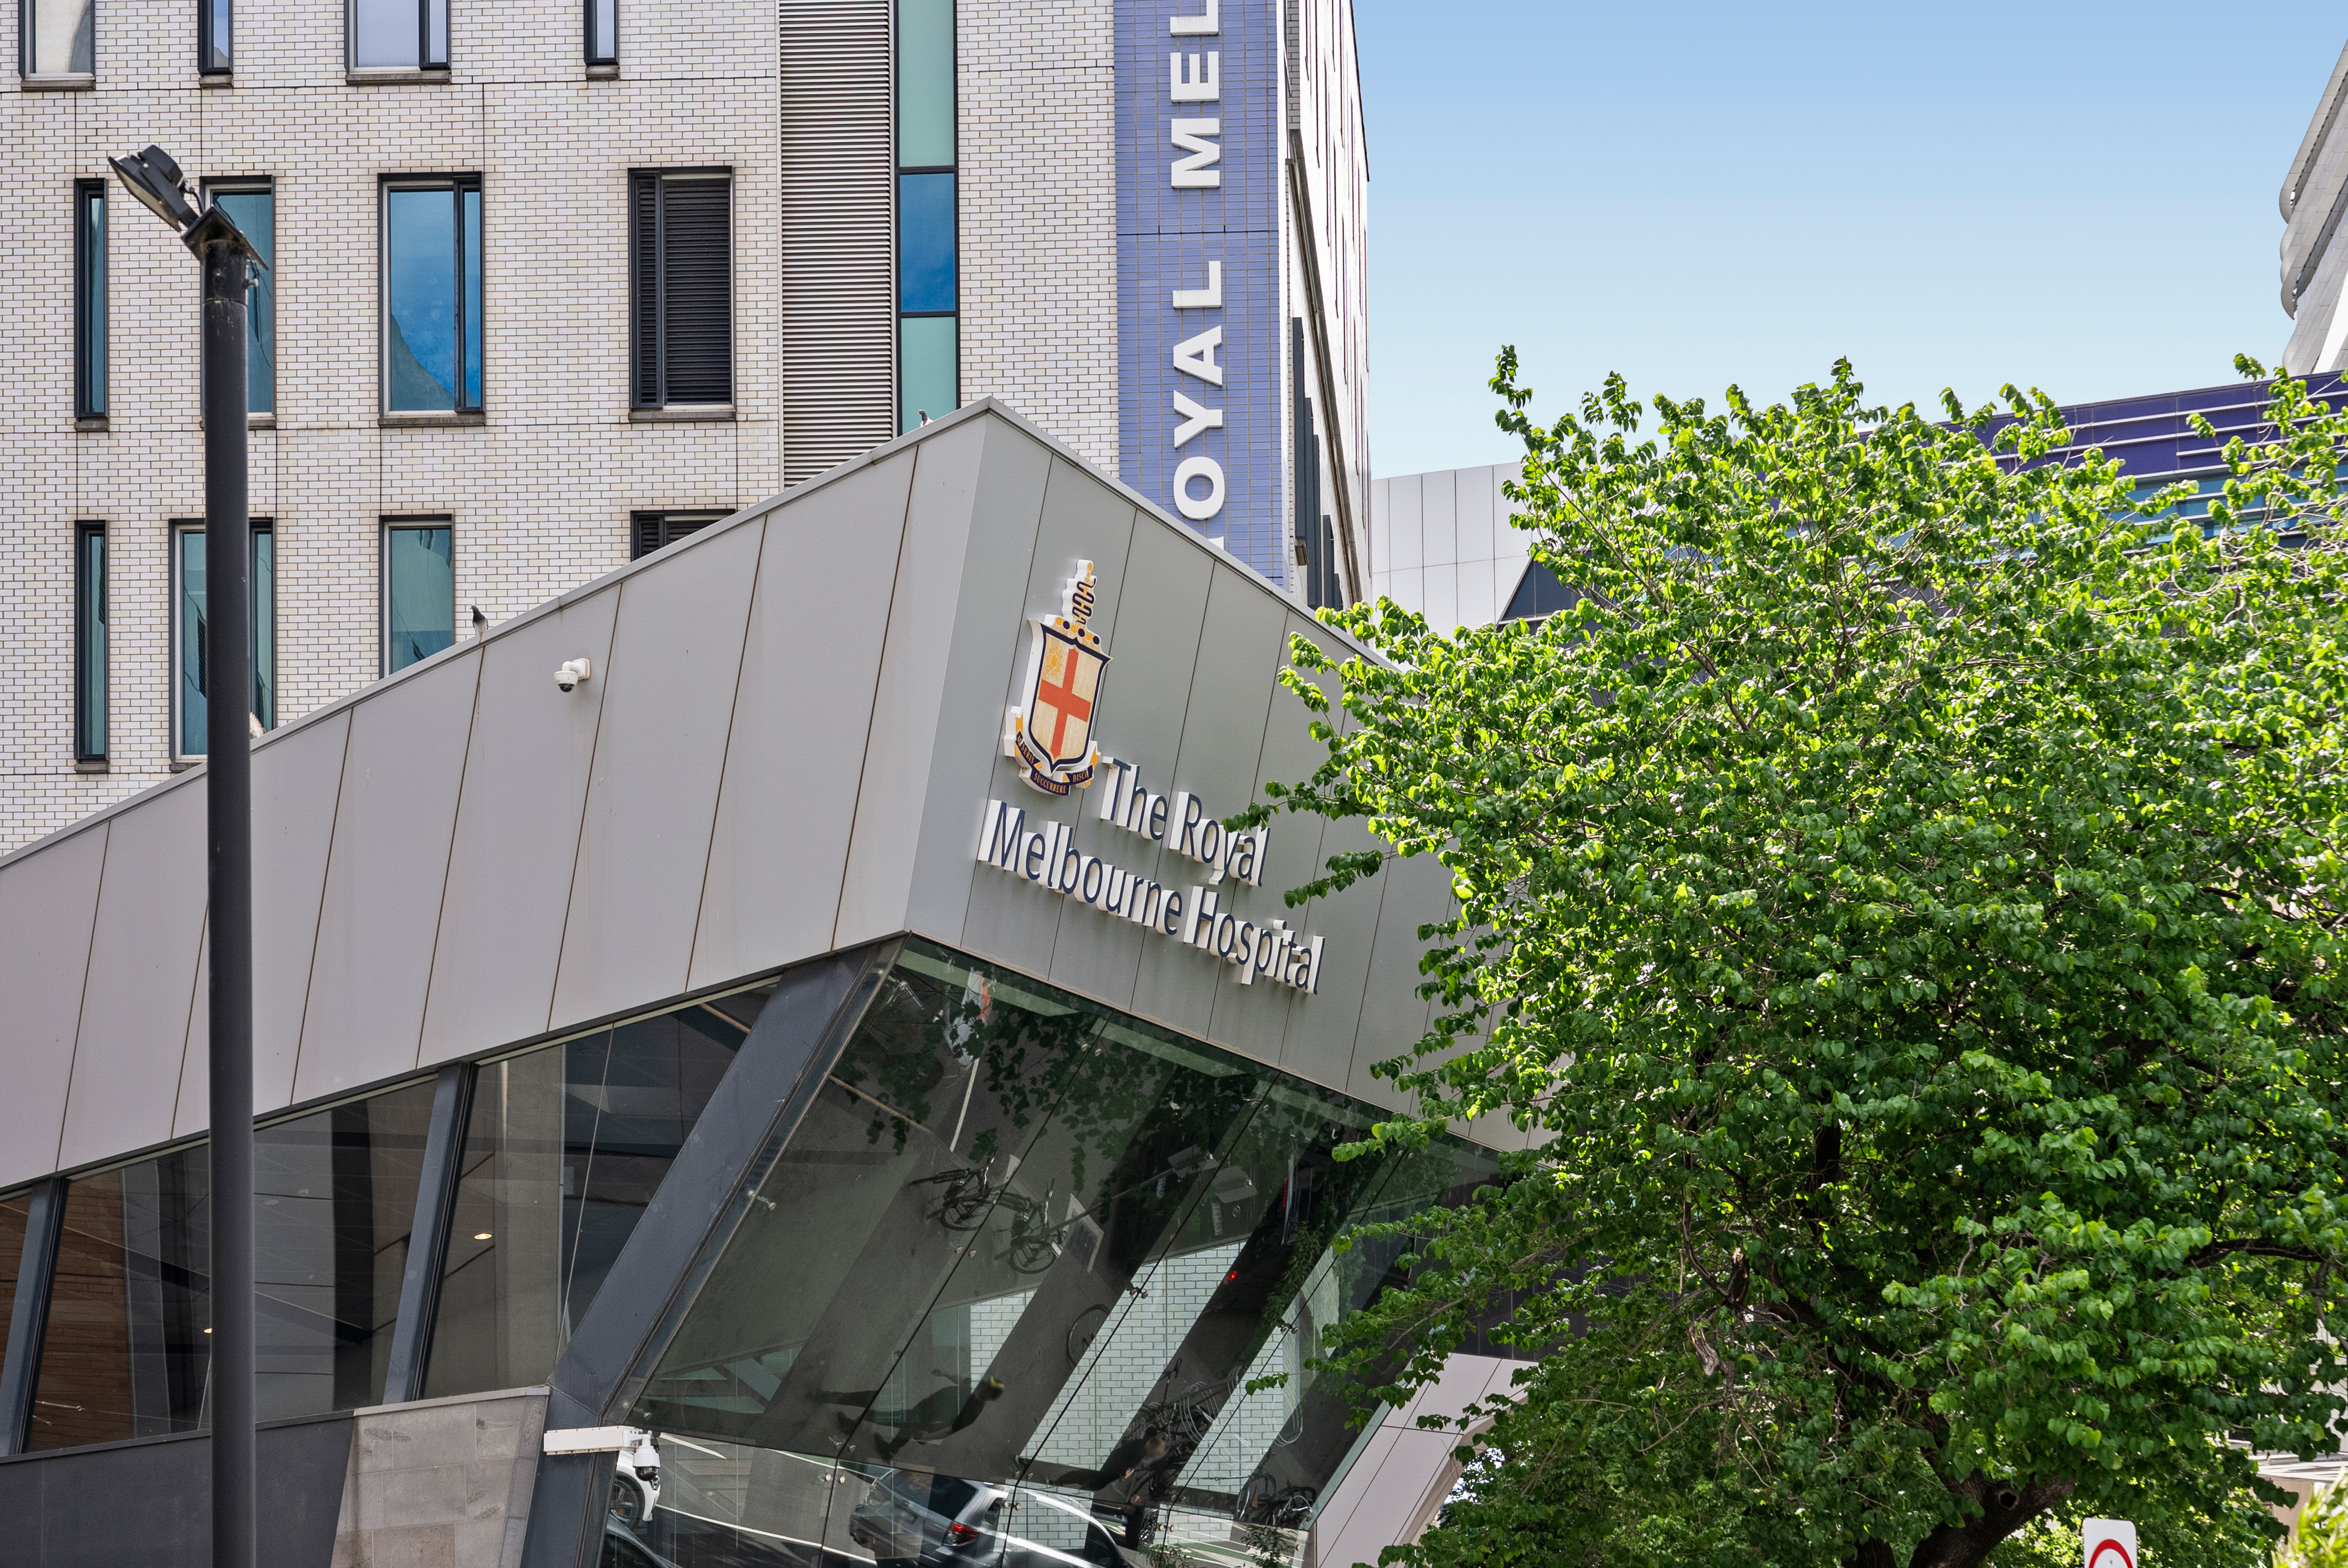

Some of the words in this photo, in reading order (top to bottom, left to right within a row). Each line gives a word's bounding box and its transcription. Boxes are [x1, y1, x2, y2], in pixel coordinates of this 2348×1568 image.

[1170, 0, 1220, 189] MEL
[1172, 260, 1226, 550] OYAL
[1033, 772, 1067, 793] SUCCURRERE
[1073, 771, 1089, 782] DISCO
[1100, 756, 1168, 840] The
[1169, 791, 1271, 887] Royal
[977, 799, 1182, 935] Melbourne
[1183, 885, 1326, 995] Hospital
